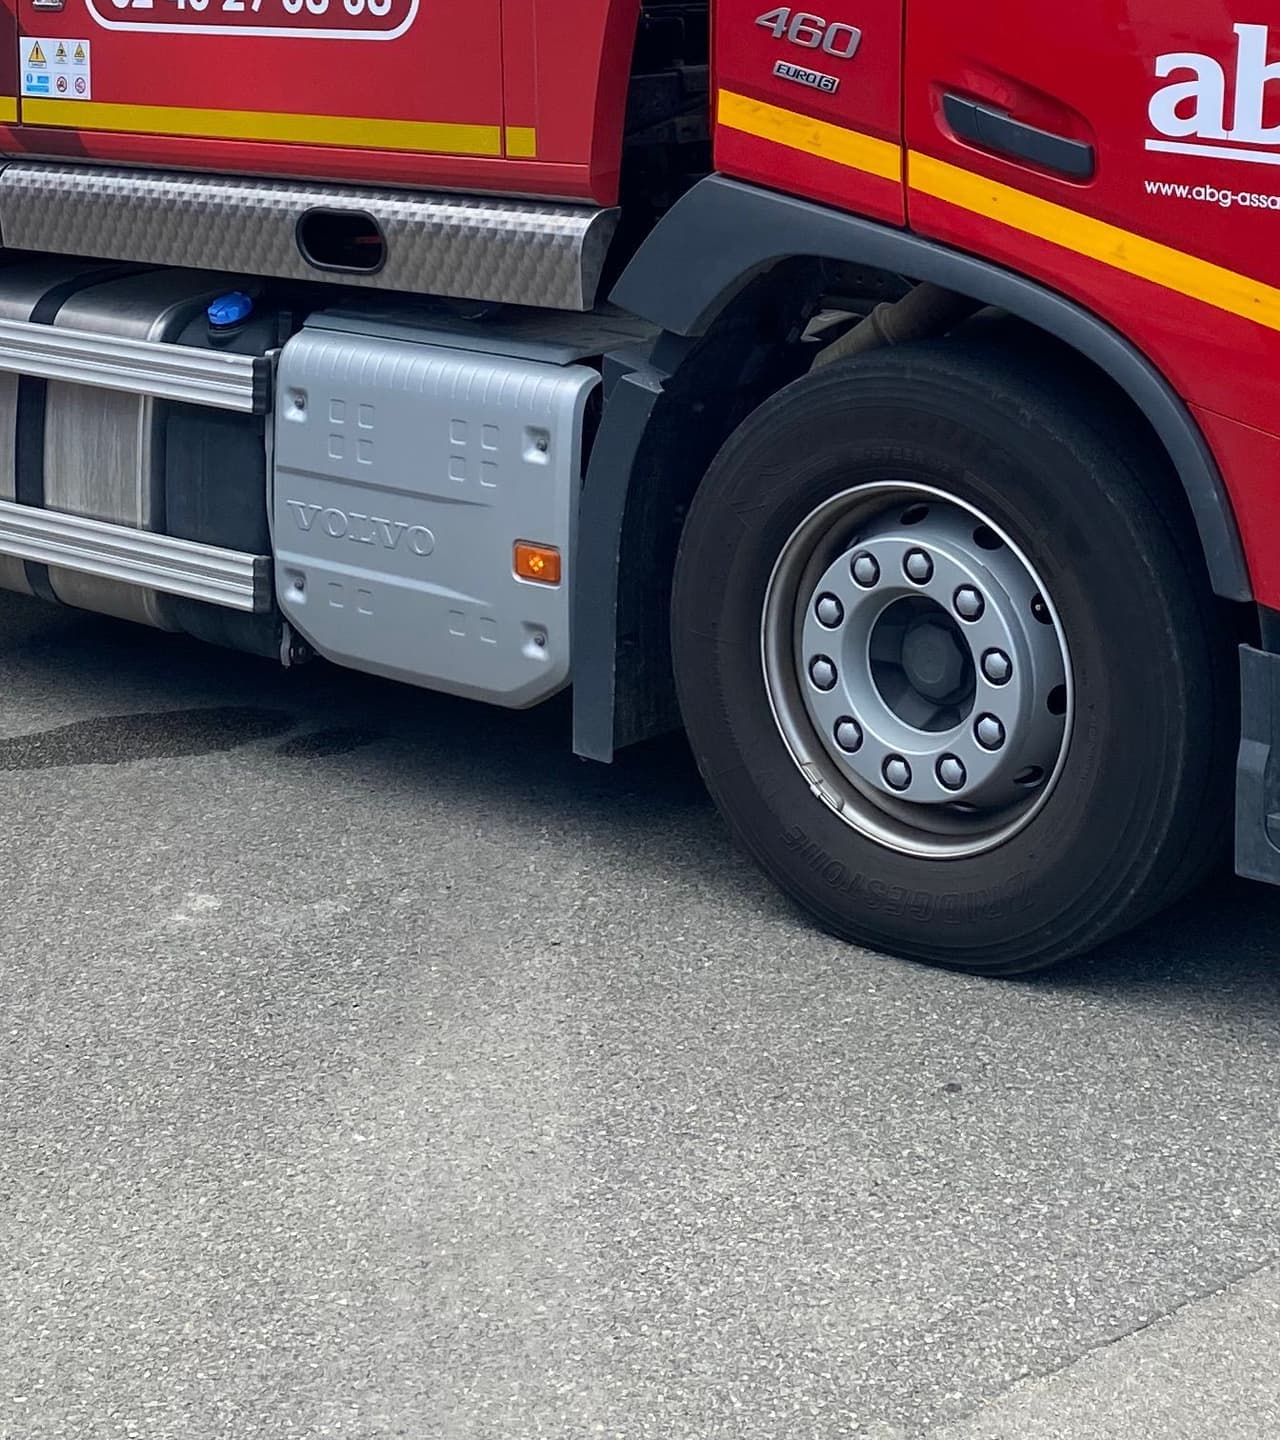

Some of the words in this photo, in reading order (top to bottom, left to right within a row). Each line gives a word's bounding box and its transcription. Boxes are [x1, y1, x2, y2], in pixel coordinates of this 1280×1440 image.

[755, 7, 862, 58] 460
[776, 63, 817, 84] EURO
[285, 499, 435, 557] VOLVO
